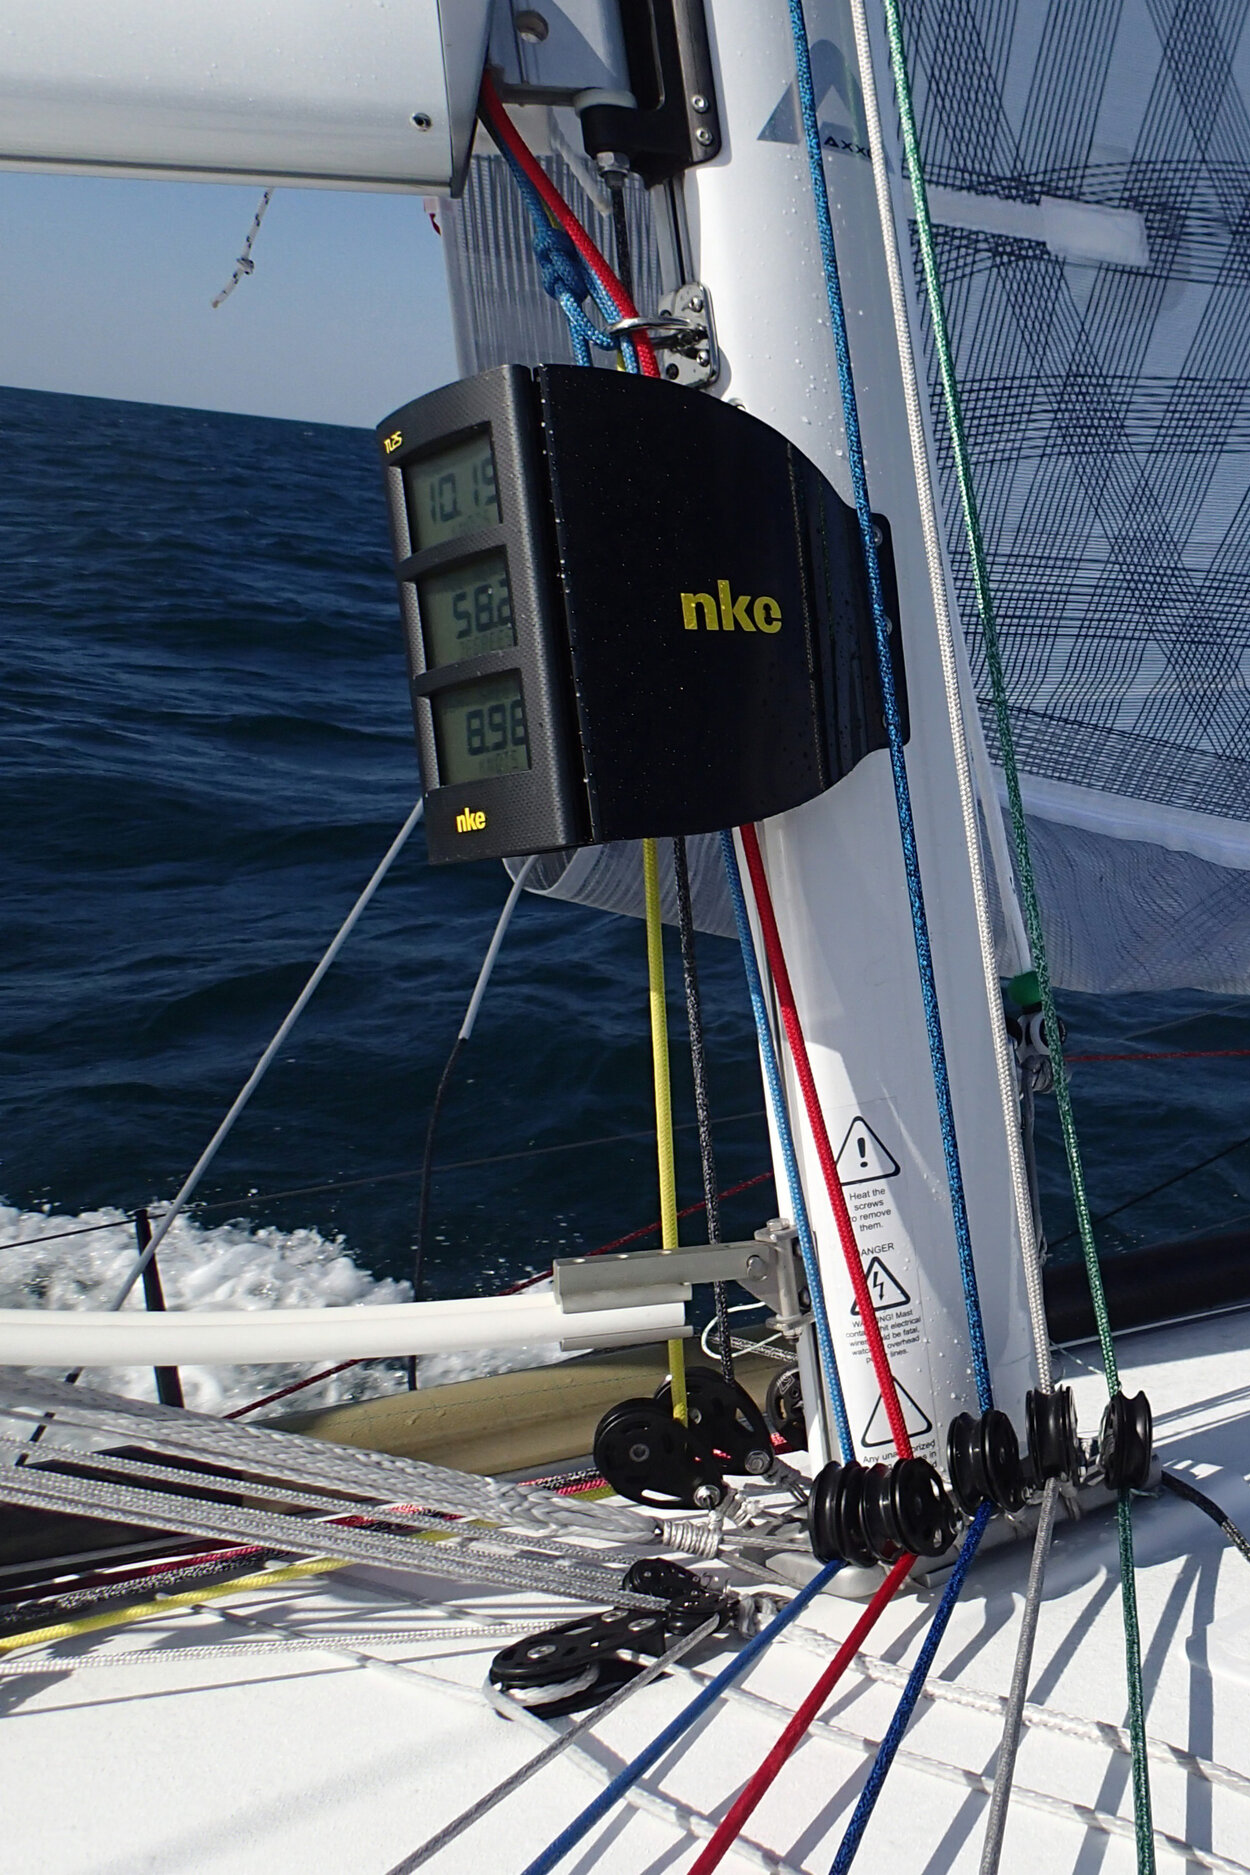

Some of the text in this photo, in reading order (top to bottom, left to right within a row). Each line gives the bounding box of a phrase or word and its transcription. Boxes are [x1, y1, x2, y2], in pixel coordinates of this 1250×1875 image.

[679, 579, 783, 634] nke
[455, 806, 487, 833] nke
[849, 1188, 886, 1201] Heat the
[854, 1200, 885, 1211] screws
[859, 1209, 892, 1221] remove
[859, 1222, 883, 1232] them.
[861, 1242, 895, 1256] ANGER
[895, 1309, 913, 1319] Mast
[890, 1316, 921, 1330] electrical
[887, 1335, 920, 1349] overhead
[863, 1455, 880, 1464] Any
